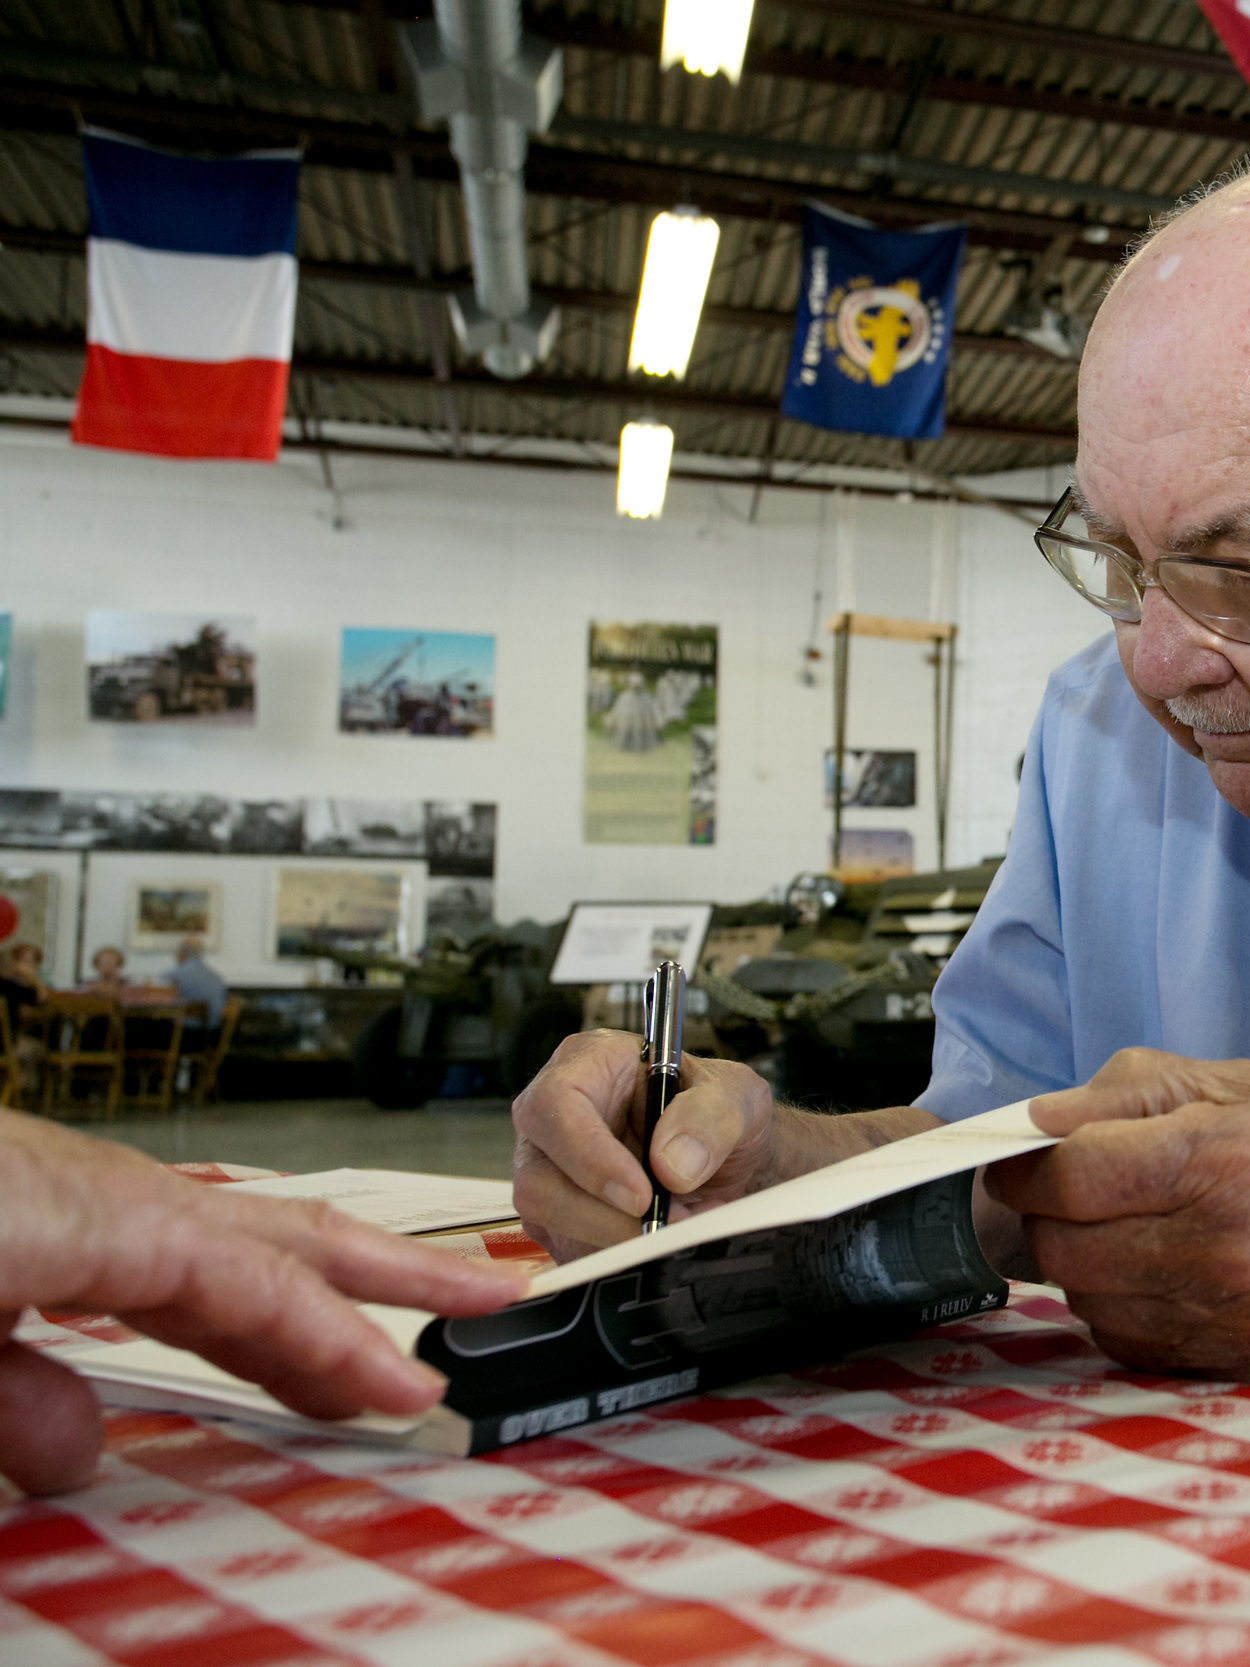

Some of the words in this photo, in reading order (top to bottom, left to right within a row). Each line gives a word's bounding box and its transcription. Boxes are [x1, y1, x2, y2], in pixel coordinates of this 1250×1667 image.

[940, 1295, 974, 1317] REILLY
[500, 1397, 589, 1444] OVER
[597, 1367, 699, 1415] THERE
